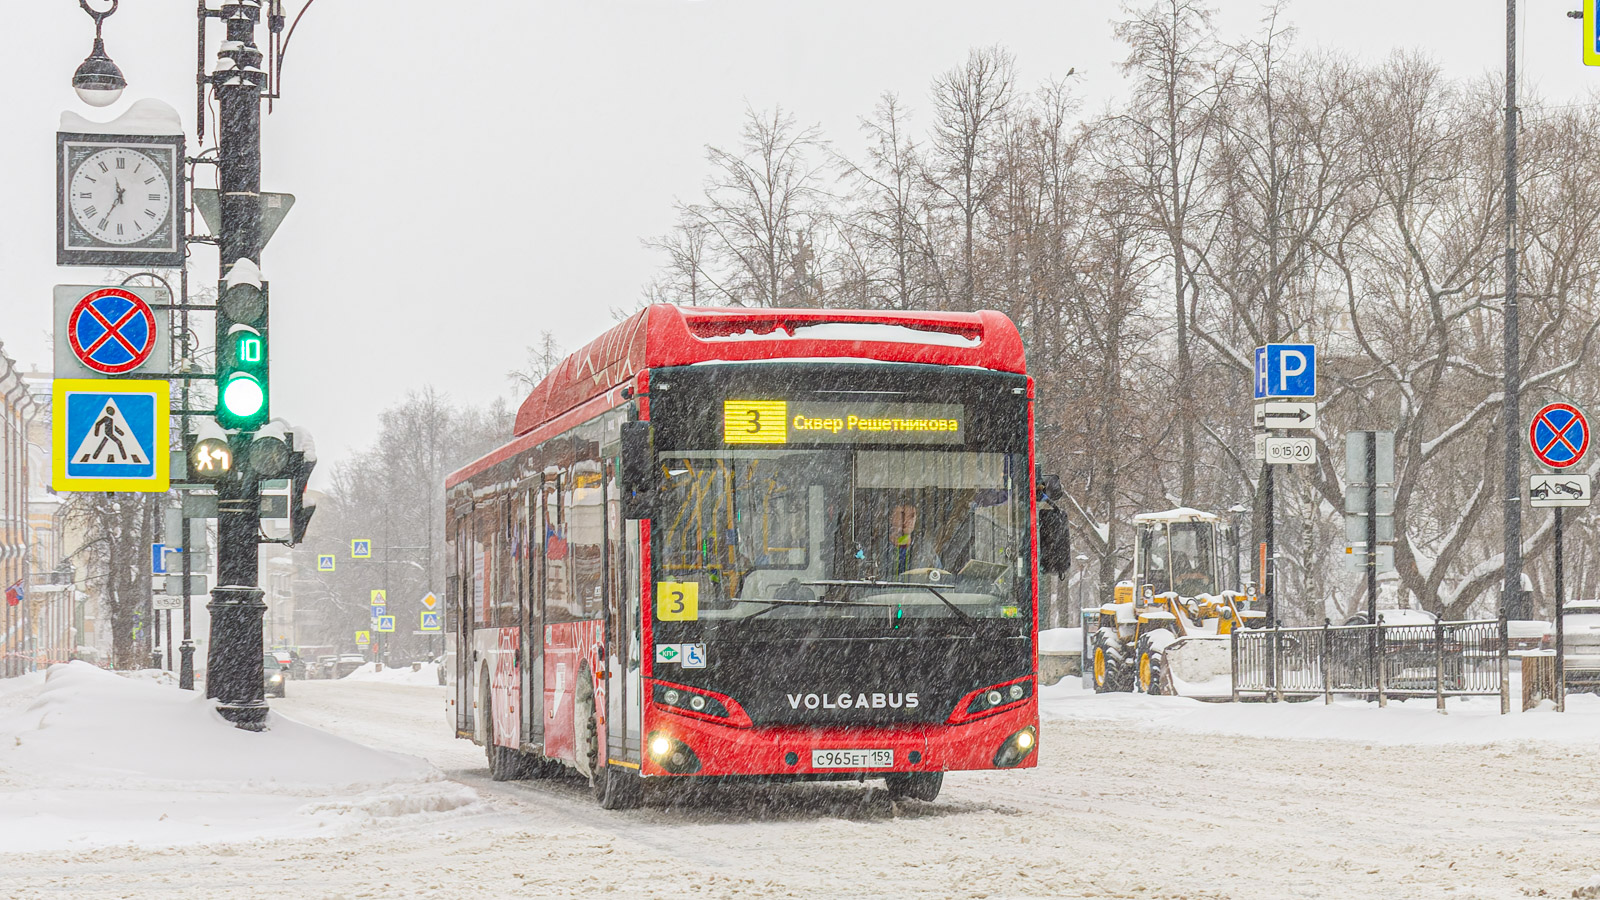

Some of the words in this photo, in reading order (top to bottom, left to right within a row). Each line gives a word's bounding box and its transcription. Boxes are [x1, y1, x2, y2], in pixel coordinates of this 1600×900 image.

[97, 161, 109, 174] XI
[116, 157, 125, 169] XII
[133, 163, 141, 173] I
[84, 174, 97, 184] X
[143, 176, 156, 185] II
[148, 193, 160, 201] III
[83, 205, 98, 219] VIII
[97, 217, 109, 231] VII
[117, 223, 124, 235] VI
[133, 219, 142, 231] V
[241, 339, 260, 361] 10
[1280, 350, 1307, 391] P
[746, 409, 761, 433] 3
[793, 415, 843, 433] Сквер
[847, 415, 958, 431] Решетникова
[1272, 447, 1280, 455] 10
[1282, 446, 1292, 456] 15
[1295, 446, 1310, 457] 20
[670, 591, 685, 613] 3
[376, 607, 384, 617] P
[787, 693, 919, 709] VOLGABUS
[871, 751, 890, 763] 159
